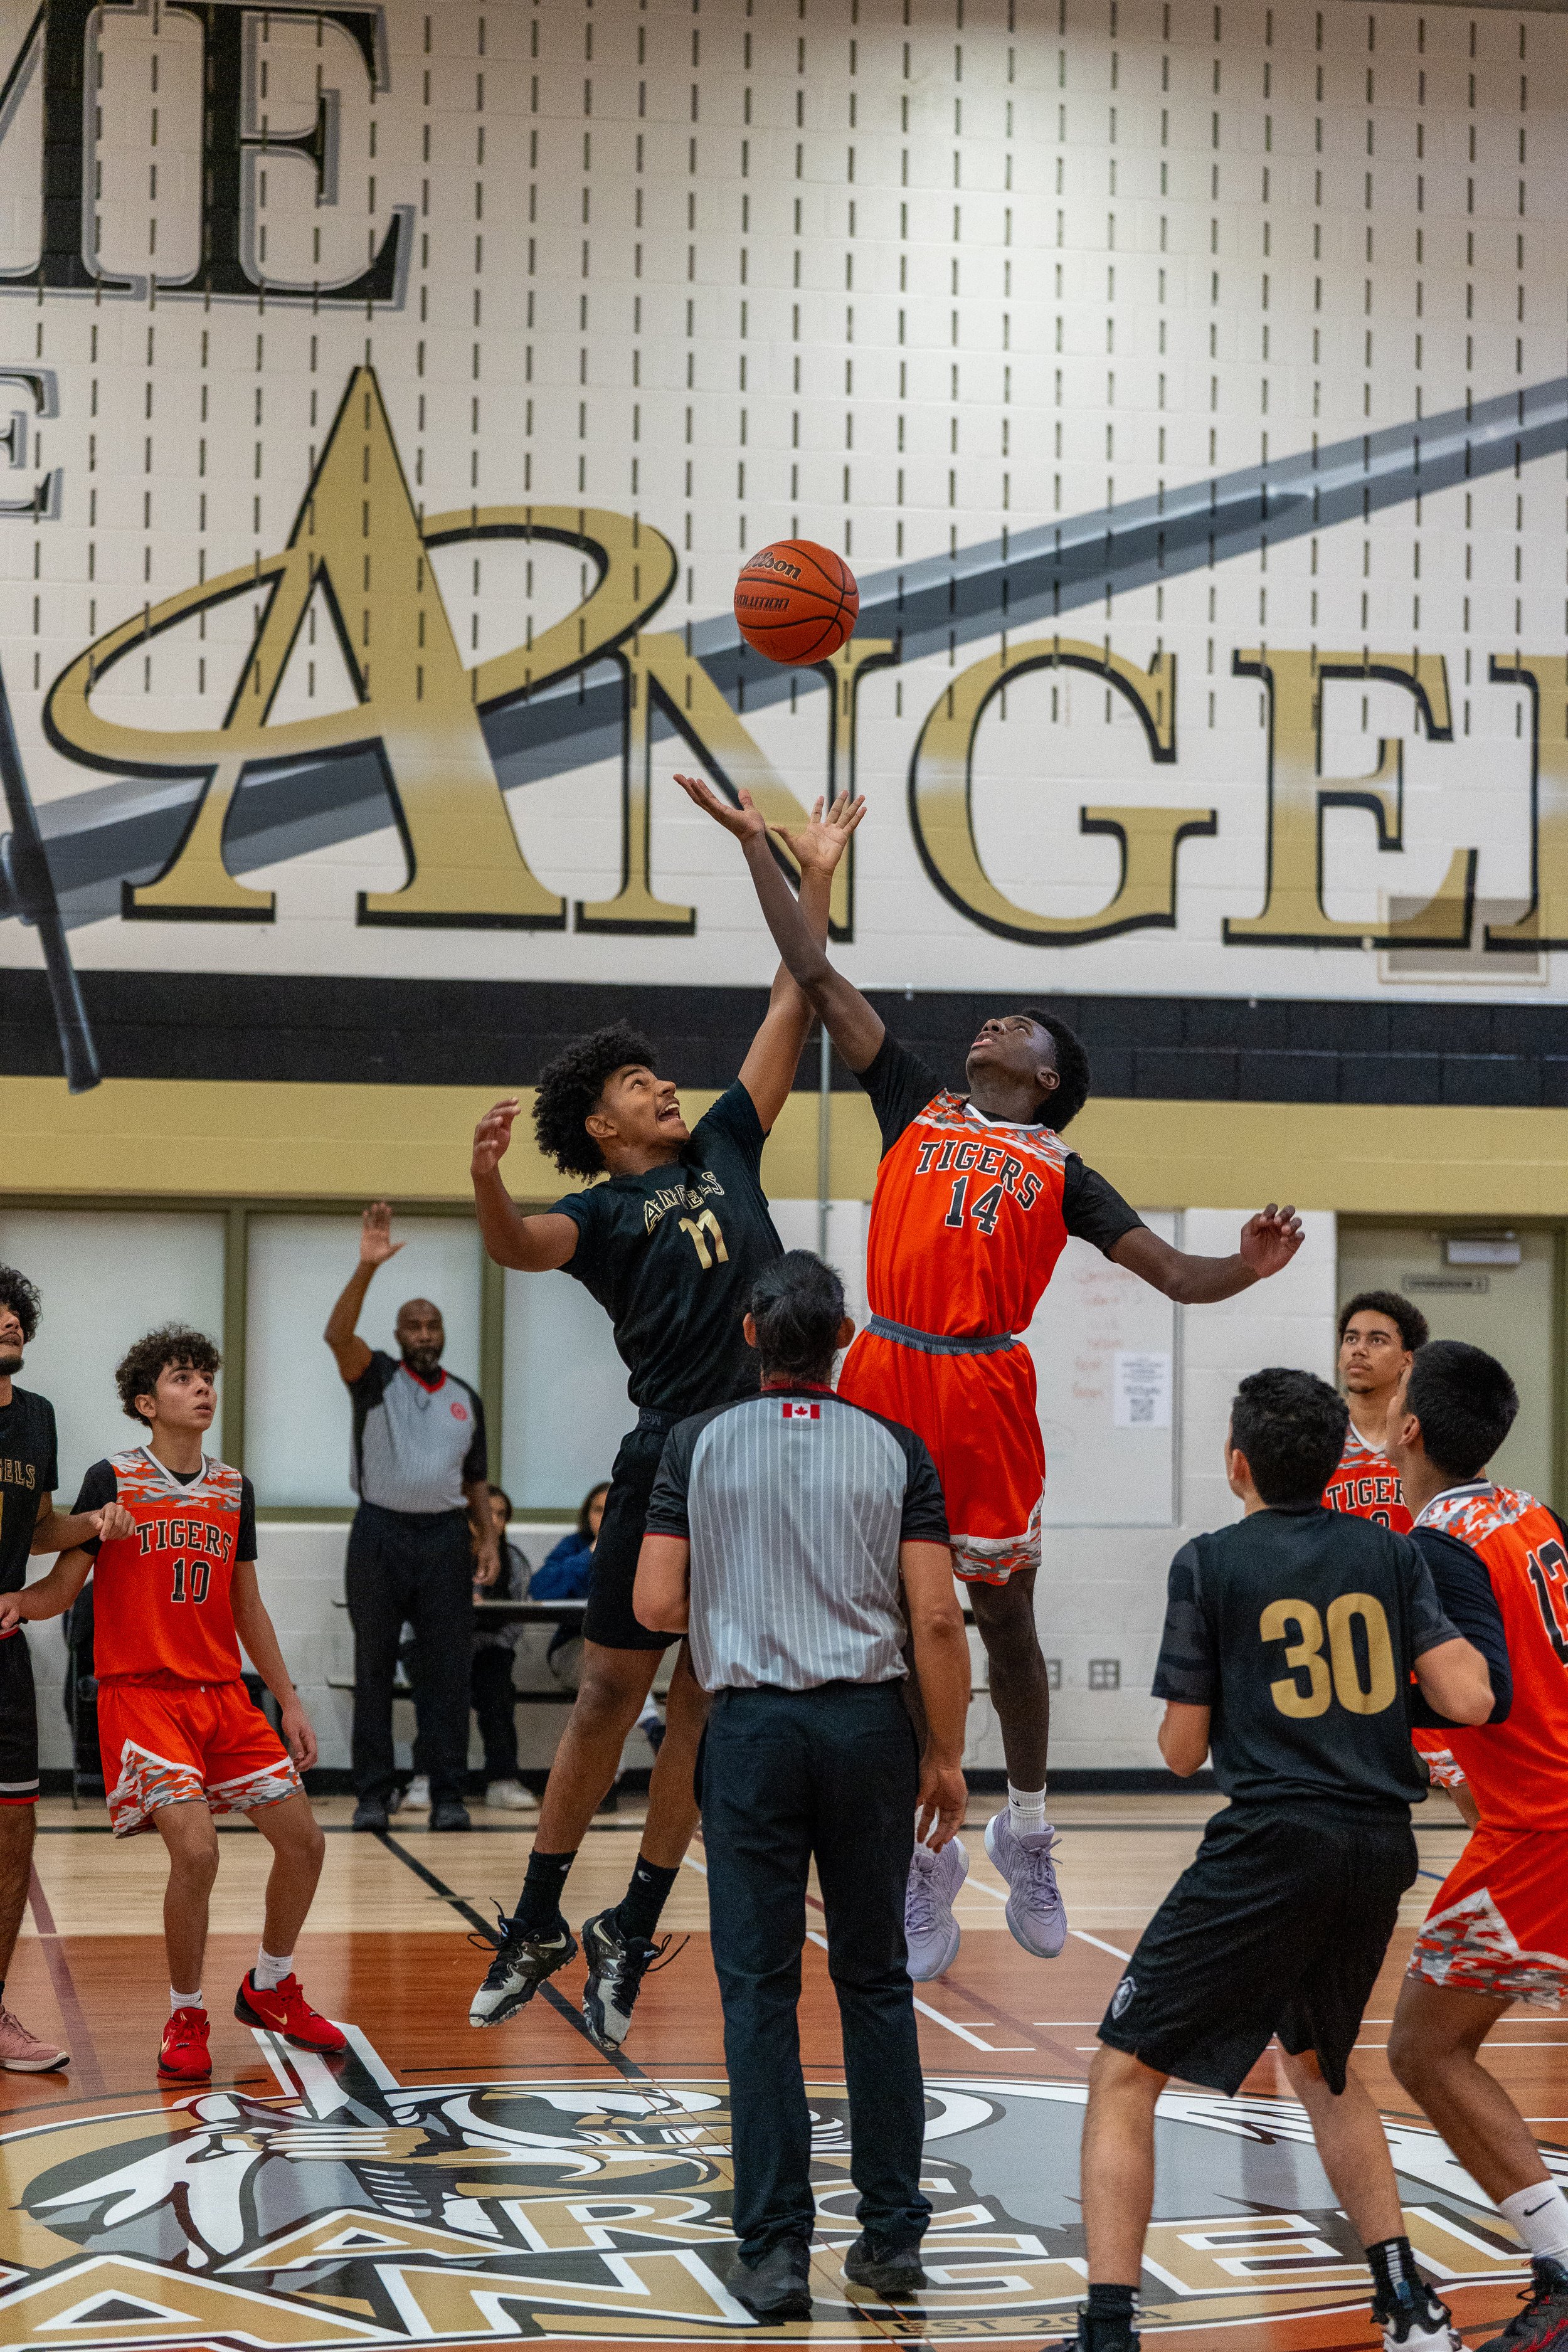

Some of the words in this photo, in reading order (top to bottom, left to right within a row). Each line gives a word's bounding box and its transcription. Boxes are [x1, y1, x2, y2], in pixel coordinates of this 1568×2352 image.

[915, 1139, 1044, 1210] TIGERS
[945, 1175, 1004, 1236] 14
[679, 1209, 729, 1269] 11
[0, 1458, 36, 1490] ELS
[135, 1518, 233, 1565] TIGERS
[171, 1557, 211, 1604] 10
[1259, 1592, 1397, 1719] 30
[893, 2320, 999, 2334] EST
